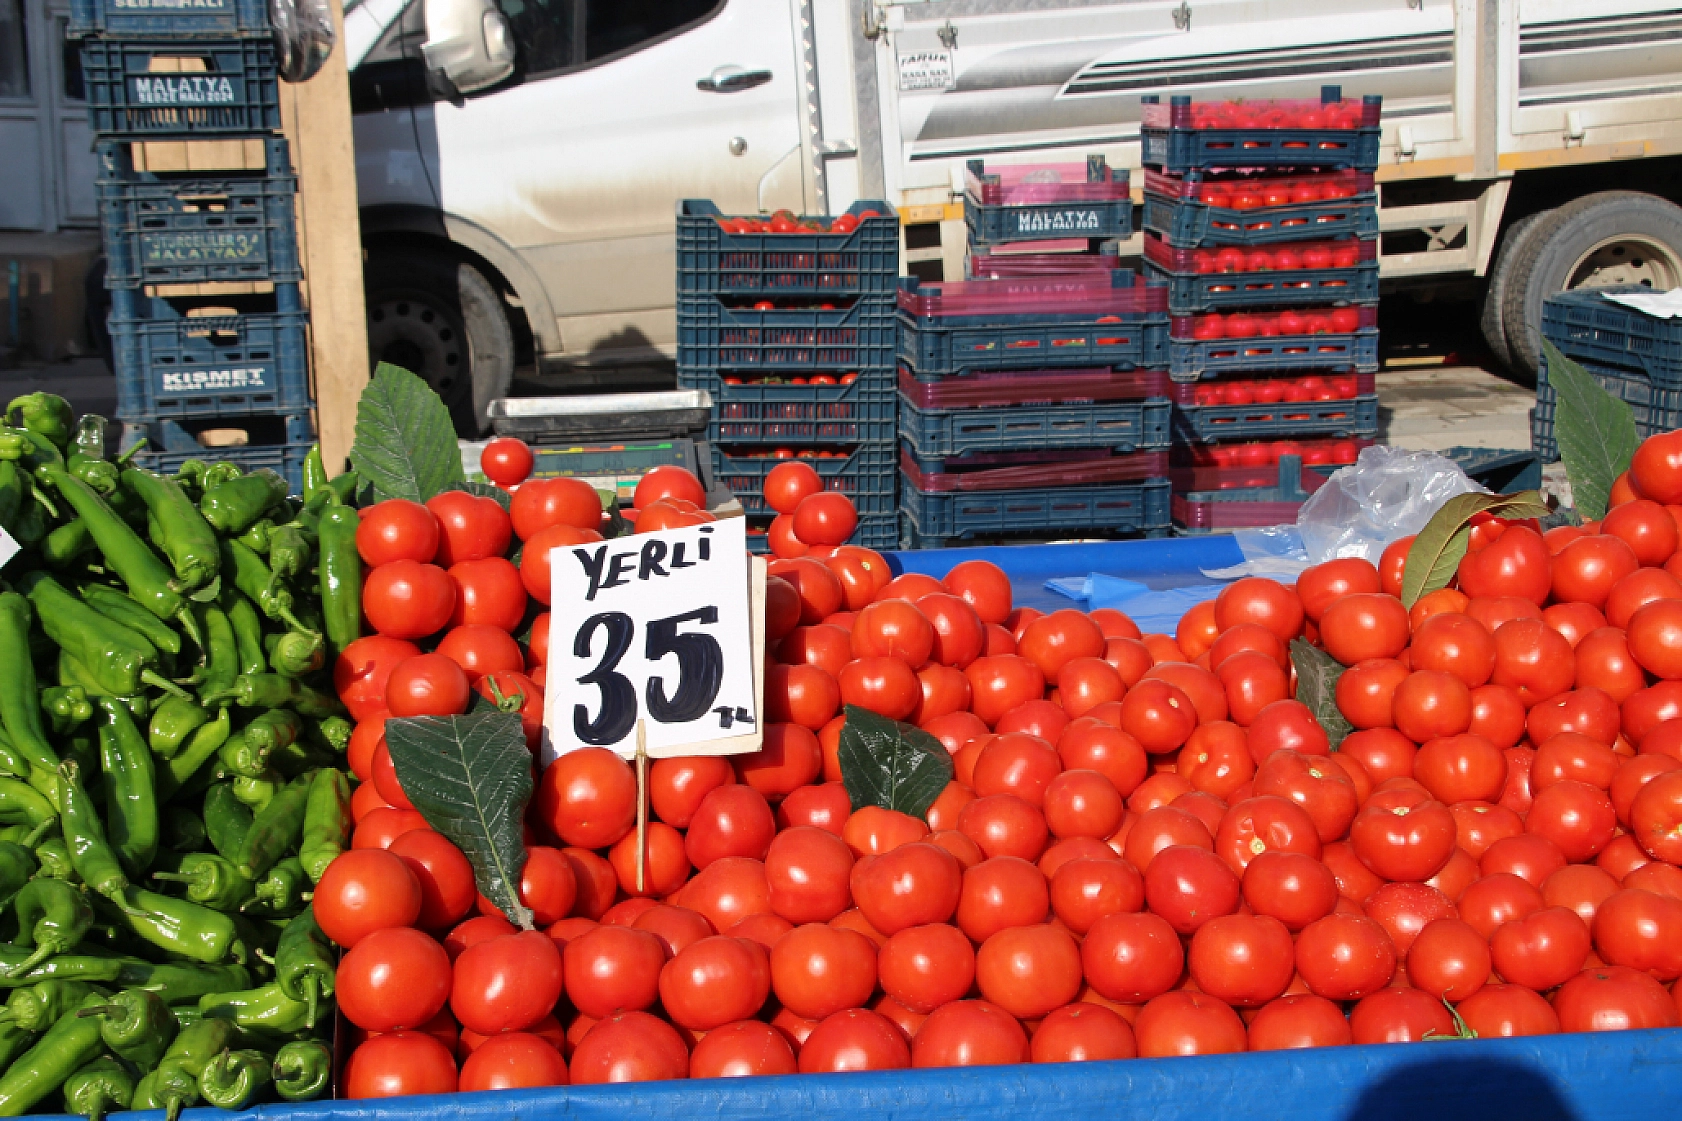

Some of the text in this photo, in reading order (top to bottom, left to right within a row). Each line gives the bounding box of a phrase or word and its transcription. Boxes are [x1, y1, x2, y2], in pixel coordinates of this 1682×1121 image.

[136, 76, 233, 93] MALATYA
[1018, 210, 1099, 226] MALATYA
[163, 368, 265, 384] KISMET
[573, 605, 755, 745] 35 TL
